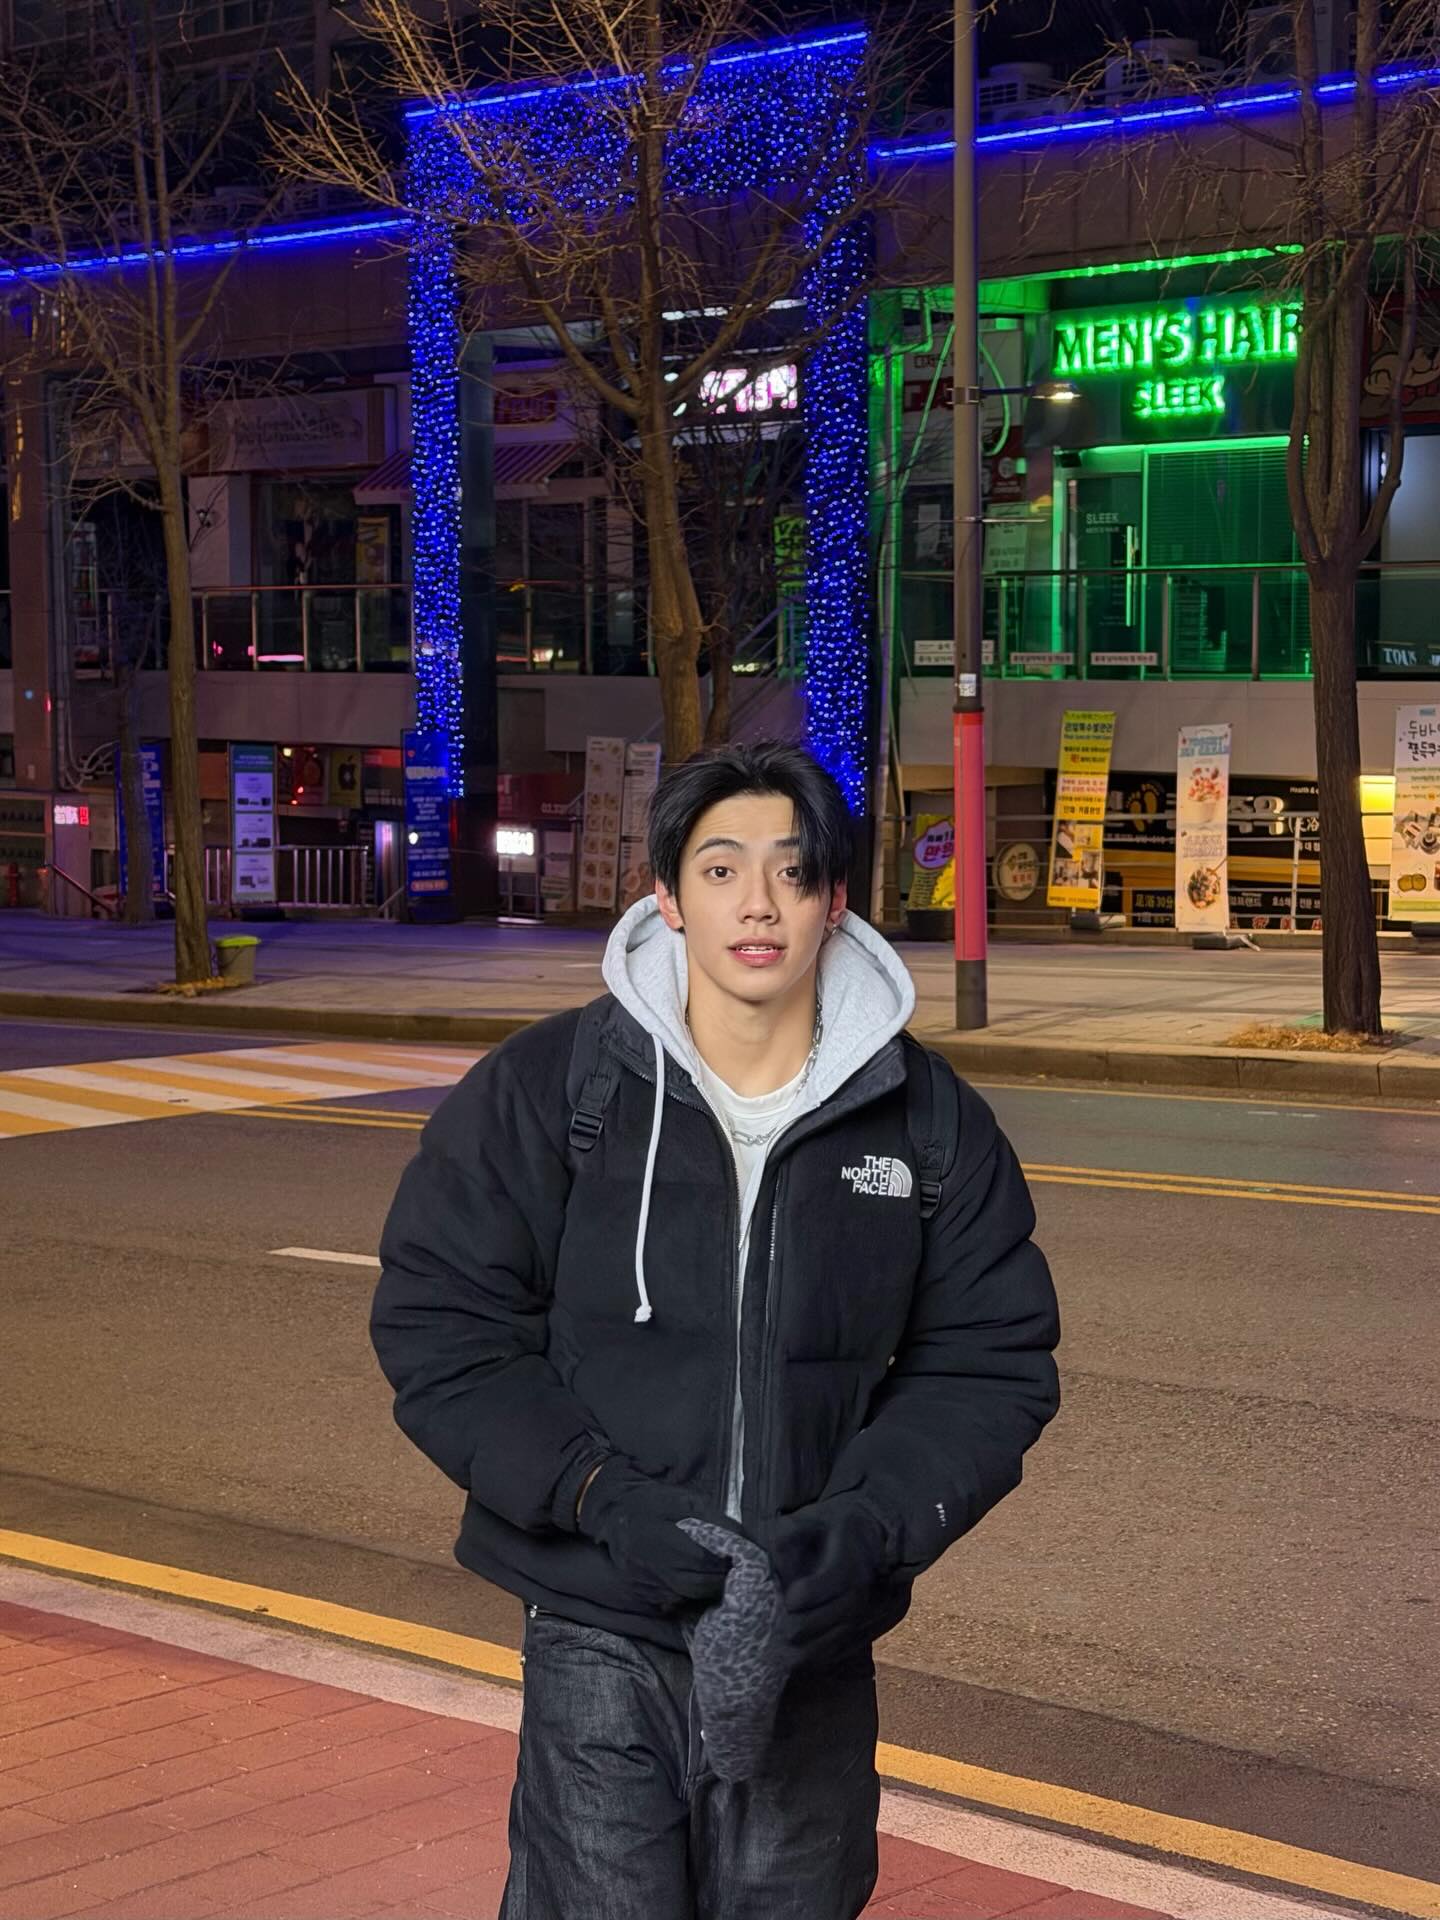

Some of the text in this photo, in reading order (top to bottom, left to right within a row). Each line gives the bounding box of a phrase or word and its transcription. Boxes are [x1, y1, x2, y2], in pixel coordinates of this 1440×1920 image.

[1053, 310, 1192, 372] MEN'S
[1133, 376, 1226, 417] SLEEK
[1086, 513, 1120, 524] SLEEK
[864, 1156, 892, 1170] THE
[841, 1166, 890, 1184] NORTH
[853, 1181, 888, 1195] FACE
